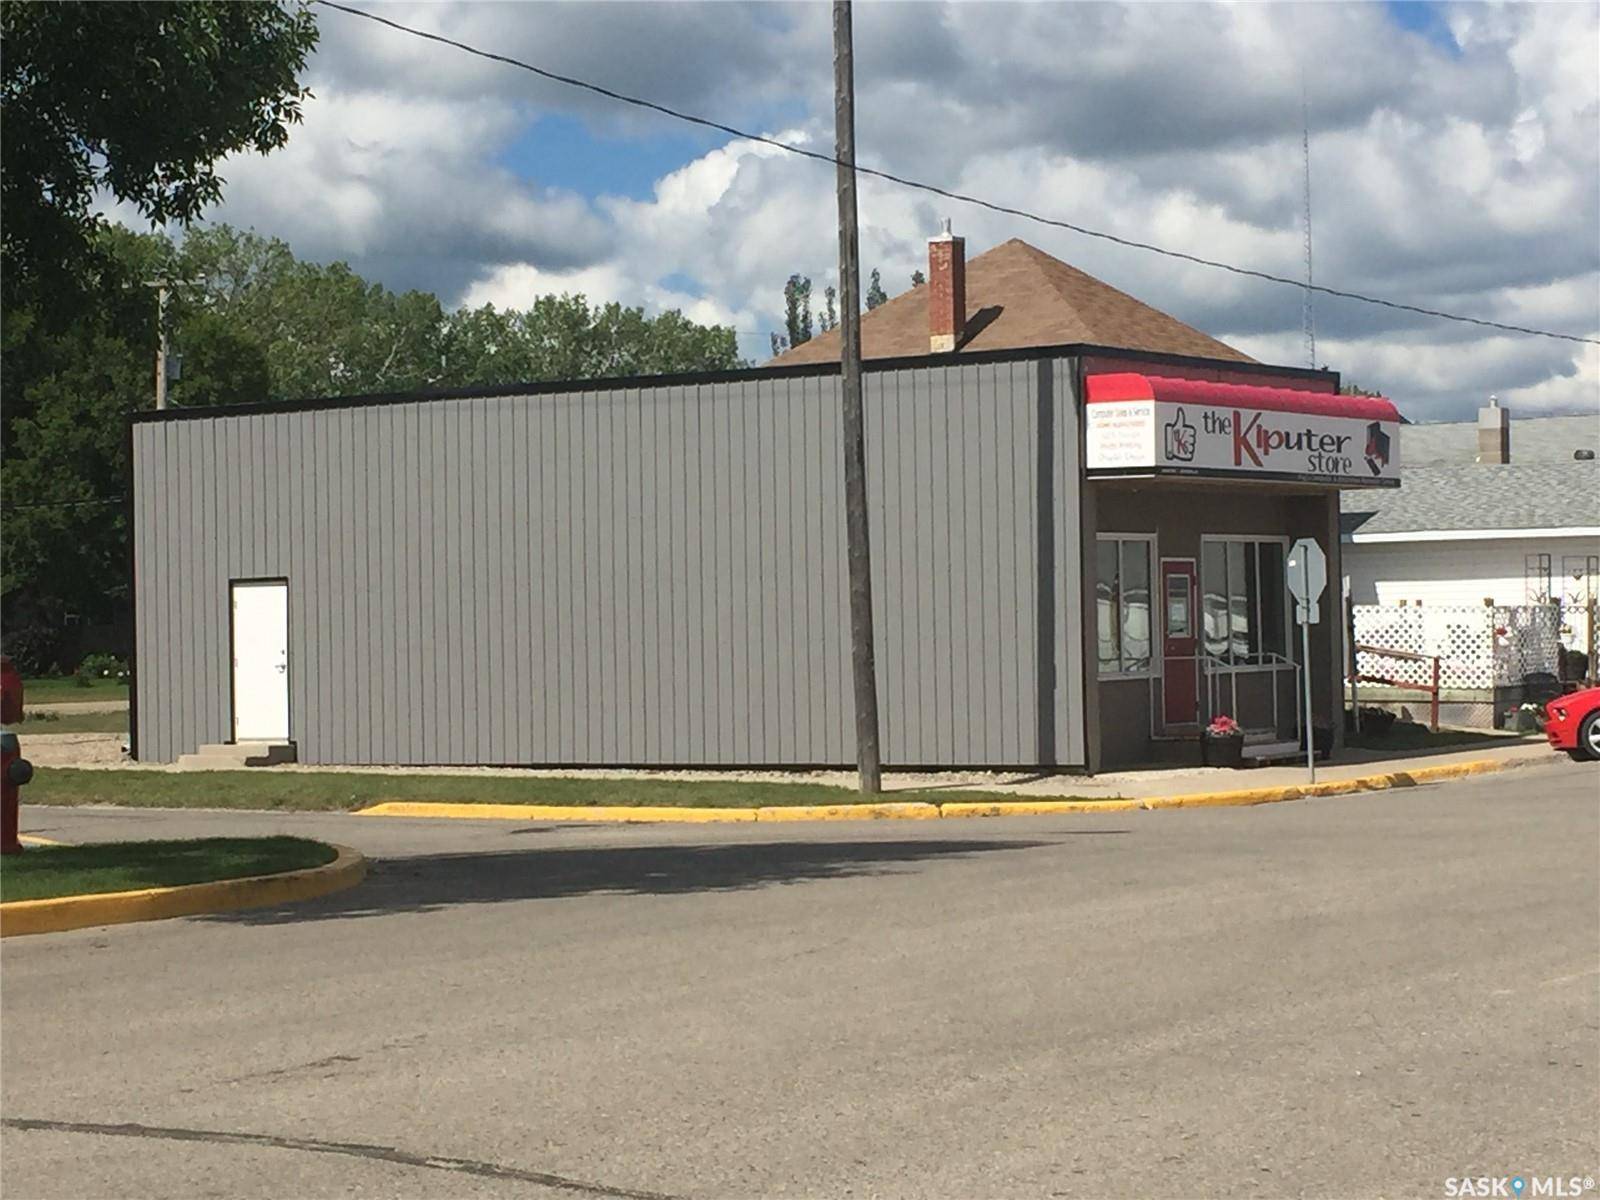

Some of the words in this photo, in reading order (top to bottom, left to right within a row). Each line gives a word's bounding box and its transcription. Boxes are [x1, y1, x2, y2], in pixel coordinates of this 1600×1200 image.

[1203, 410, 1231, 435] the
[1233, 410, 1352, 467] Kiputer
[1308, 454, 1352, 474] store
